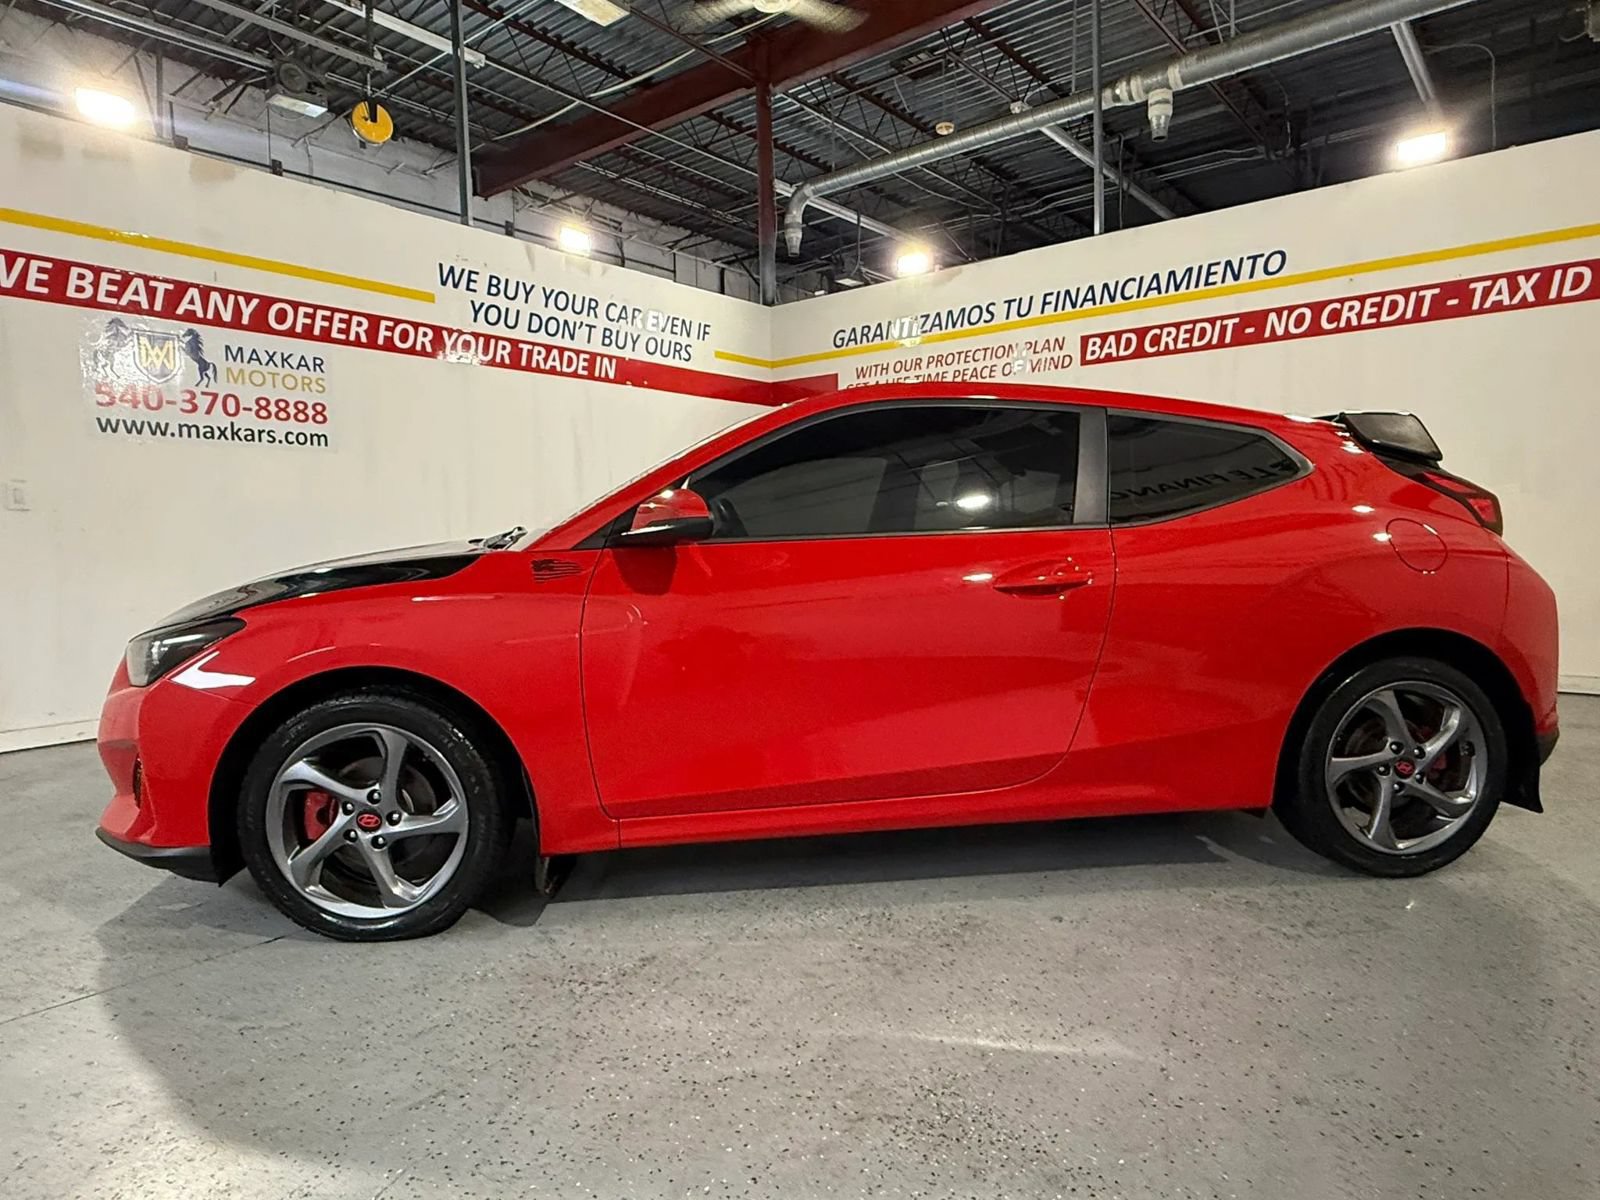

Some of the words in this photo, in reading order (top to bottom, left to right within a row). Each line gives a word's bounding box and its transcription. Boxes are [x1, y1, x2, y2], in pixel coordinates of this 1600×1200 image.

[439, 262, 479, 293] WE
[487, 274, 535, 304] BUY
[542, 287, 599, 318] YOUR
[605, 302, 644, 329] CAR
[646, 309, 692, 338] EVEN
[697, 322, 711, 341] IF
[833, 302, 996, 349] GARANTIZAMOS
[1004, 294, 1034, 318] TU
[1040, 249, 1287, 315] FINANCIAMIENTO
[1085, 331, 1137, 361] BAD
[1143, 317, 1240, 353] CREDIT
[1263, 307, 1312, 338] NO
[1320, 288, 1441, 329] CREDIT
[1467, 271, 1541, 311] TAX
[1547, 265, 1592, 298] ID
[66, 266, 174, 311] BEAT
[175, 287, 260, 325] ANY
[267, 302, 367, 343] OFFER
[377, 325, 433, 353] FOR
[441, 331, 511, 365] YOUR
[518, 343, 590, 376] TRADE
[594, 357, 617, 379] IN
[470, 300, 520, 329] YOU
[527, 312, 597, 345] DON'T
[601, 327, 641, 352] BUY
[645, 336, 692, 362] OURS
[224, 344, 325, 373] MAXKAR
[855, 361, 889, 379] WITH
[893, 356, 922, 374] OUR
[926, 342, 1018, 370] PROTECTION
[1022, 336, 1066, 356] PLAN
[952, 364, 997, 383] PEACE
[1026, 354, 1073, 374] MIND
[225, 367, 326, 394] MOTORS
[95, 383, 328, 425] 540-370-8888
[96, 416, 329, 447] www.maxkars.com
